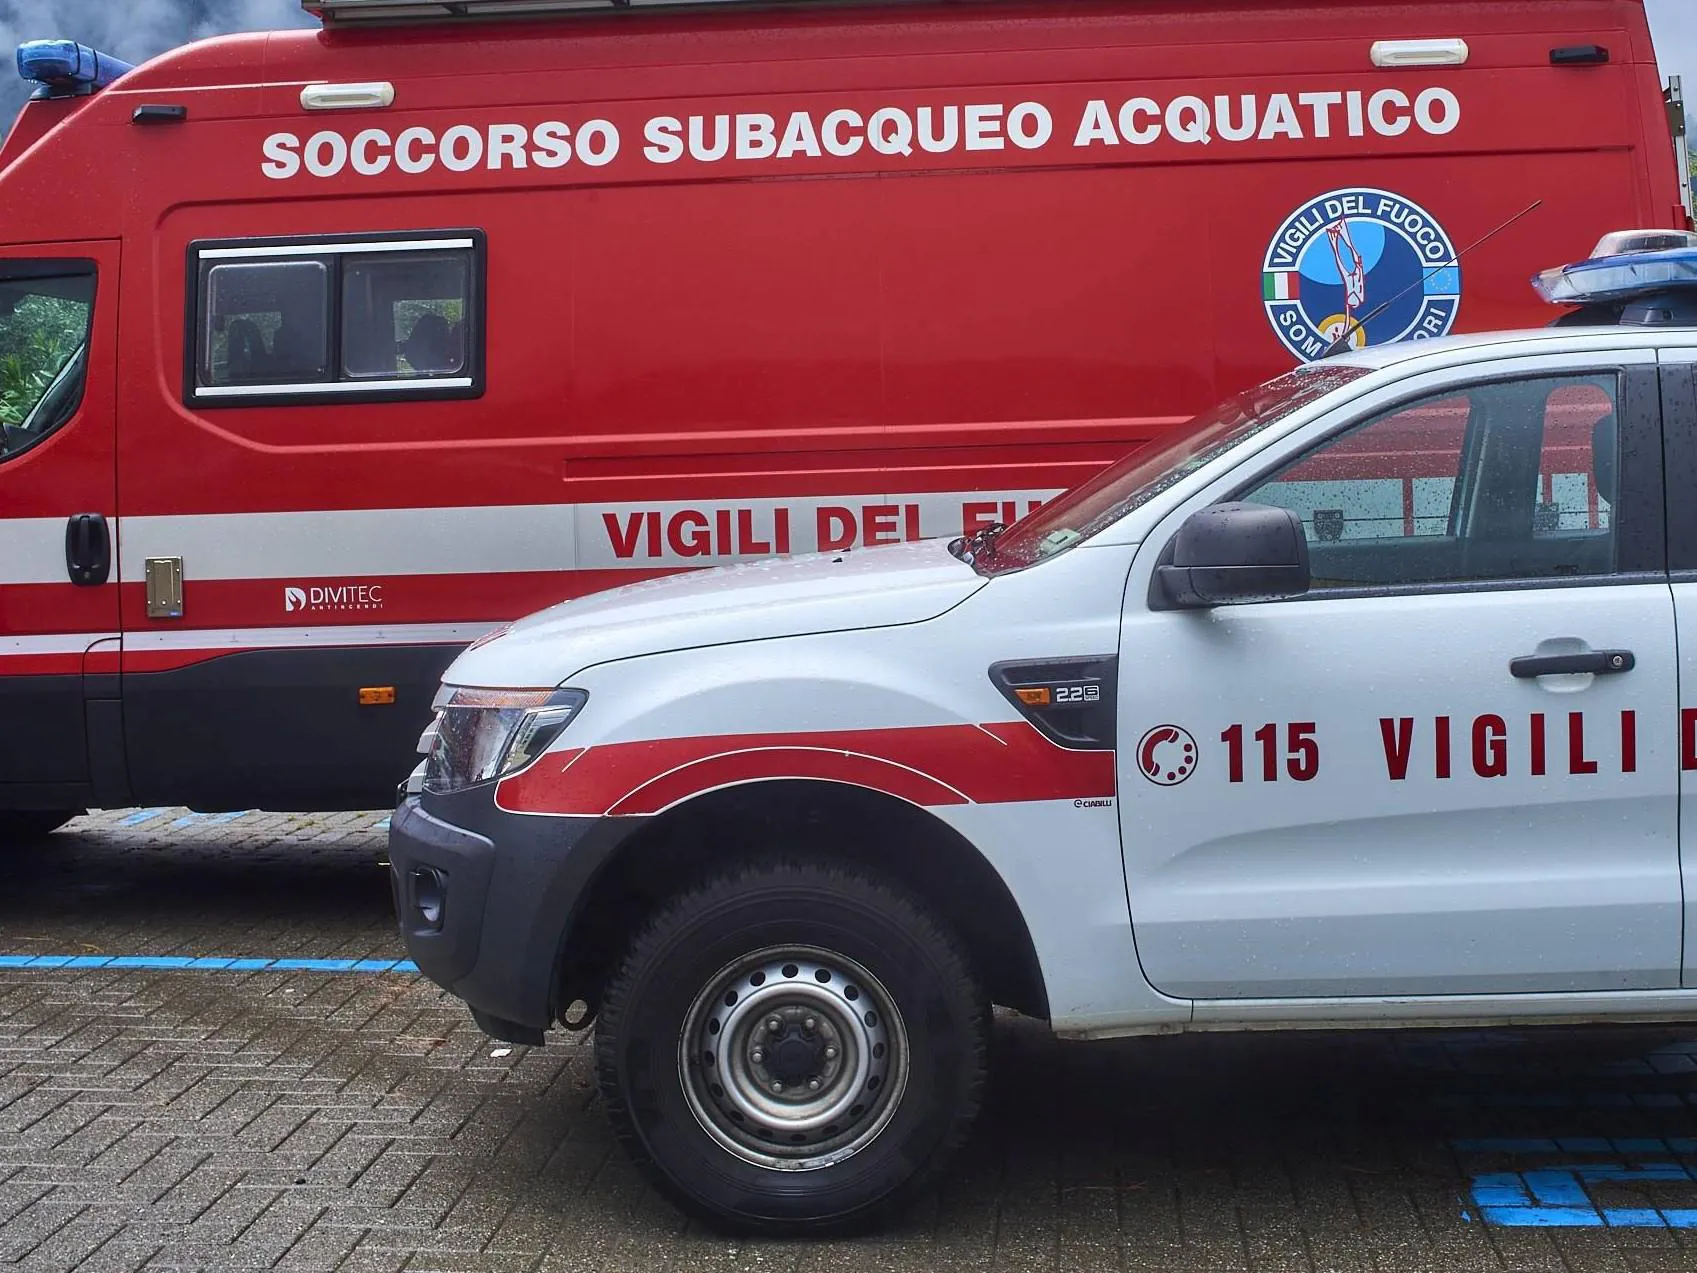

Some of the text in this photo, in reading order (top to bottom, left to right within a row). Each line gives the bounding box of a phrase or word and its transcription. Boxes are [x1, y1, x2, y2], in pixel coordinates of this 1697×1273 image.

[261, 87, 1461, 179] SOCCORSO SUBACQUEO ACQUATICO
[1273, 195, 1445, 265] VIGILI DEL FUOCO
[602, 507, 790, 558] VIGILI
[310, 585, 383, 604] DIVITEC
[1220, 721, 1320, 783] 115
[1379, 708, 1637, 781] VIGILI
